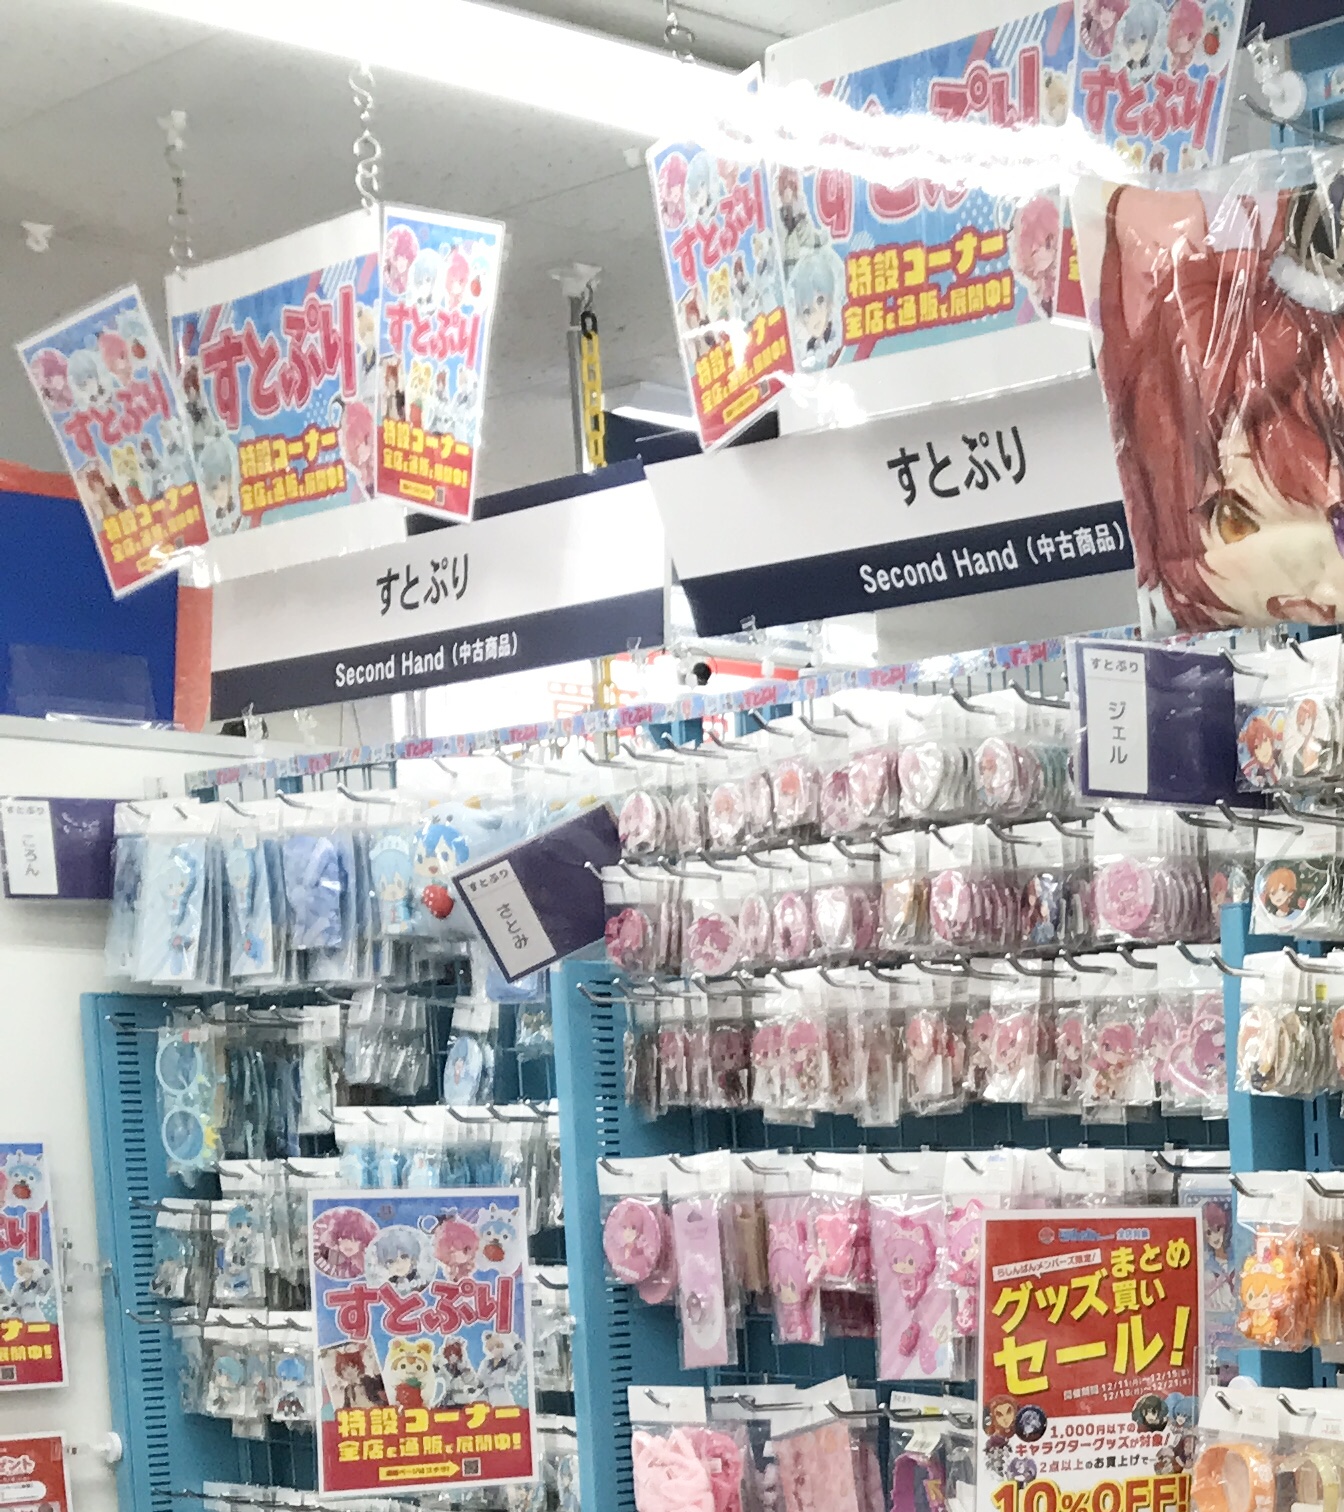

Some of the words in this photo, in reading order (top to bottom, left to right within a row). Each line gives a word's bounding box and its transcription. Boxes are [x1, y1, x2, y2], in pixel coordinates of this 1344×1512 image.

[1080, 67, 1218, 149] すとぷり
[672, 172, 764, 280] すとぷり
[848, 232, 1004, 298] 特設コーナー
[205, 285, 356, 429] すとぷり
[385, 306, 481, 369] すとぷり
[65, 370, 171, 456] すとぷり
[383, 421, 470, 457] 特設コーナー
[240, 428, 337, 476] 特設コーナー
[887, 425, 1028, 506] すとぷり
[376, 552, 470, 615] すとぷり
[859, 545, 948, 594] Second
[957, 534, 1018, 578] Hand
[1027, 519, 1126, 566] （中古商品）
[335, 659, 395, 690] Second
[401, 646, 444, 675] Hand
[451, 631, 519, 668] （中古商品）
[1090, 655, 1140, 675] すとぷり
[1106, 698, 1130, 767] ジェル
[467, 867, 509, 893] すとぷり
[496, 903, 528, 951] さとみ
[1110, 1237, 1191, 1277] まとめ
[325, 1276, 513, 1340] すとぷり
[991, 1269, 1108, 1334] グッズ
[1113, 1277, 1166, 1315] 買い
[994, 1306, 1191, 1396] セール!
[337, 1403, 521, 1438] 特設コーナー
[1050, 1422, 1136, 1439] 1,000円以下の
